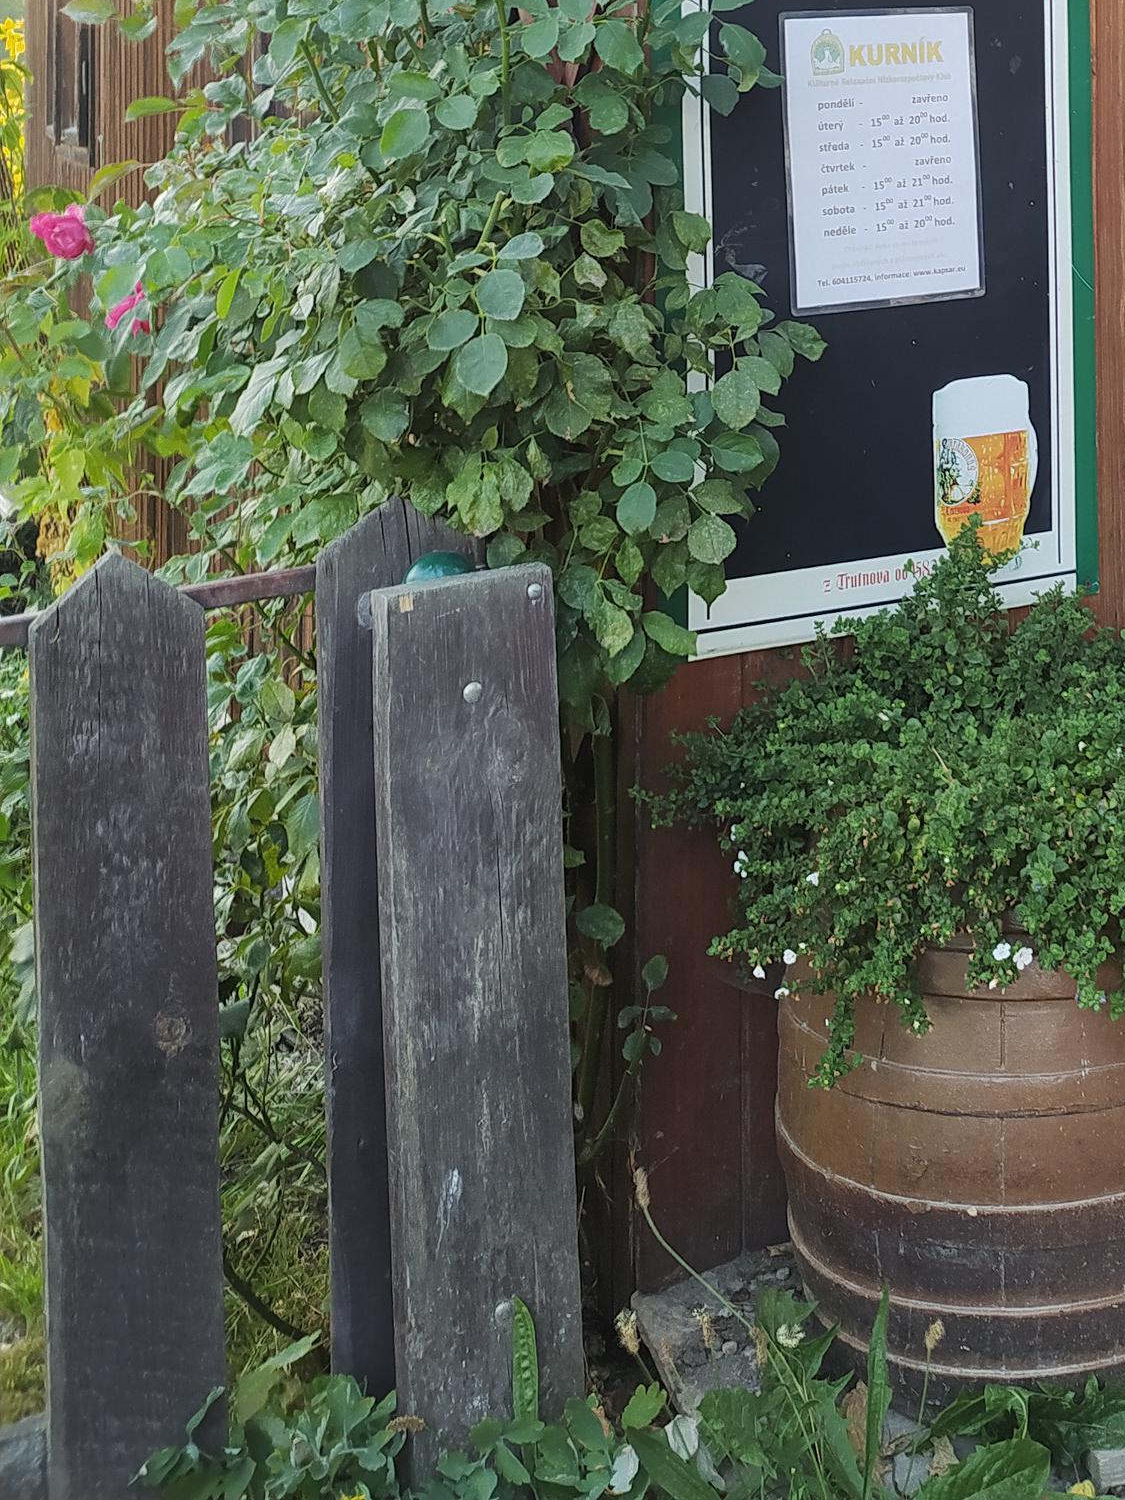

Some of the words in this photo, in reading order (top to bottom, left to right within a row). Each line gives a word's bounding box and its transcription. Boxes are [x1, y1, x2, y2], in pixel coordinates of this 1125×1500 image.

[849, 36, 945, 68] KURNÍK
[817, 98, 855, 111] pondělí
[911, 93, 949, 104] zavřeno
[818, 121, 844, 132] úterý
[894, 116, 904, 126] až
[929, 114, 950, 124] hod.
[819, 141, 850, 152] středa
[894, 138, 904, 147] až
[930, 134, 951, 144] hod.
[820, 162, 855, 173] čtvrtek
[914, 155, 952, 166] zavřeno
[821, 184, 849, 196] pátek
[896, 178, 907, 188] až
[931, 175, 953, 185] hod.
[822, 205, 855, 216] sobota
[898, 200, 908, 209] až
[933, 196, 954, 206] hod.
[823, 226, 857, 237] neděle
[899, 221, 909, 230] až
[934, 217, 955, 227] hod.
[817, 279, 831, 288] Tel.
[874, 271, 912, 281] informace:
[913, 265, 966, 277] www.kapsar.eu
[824, 580, 832, 593] z
[836, 568, 890, 591] Trutnova
